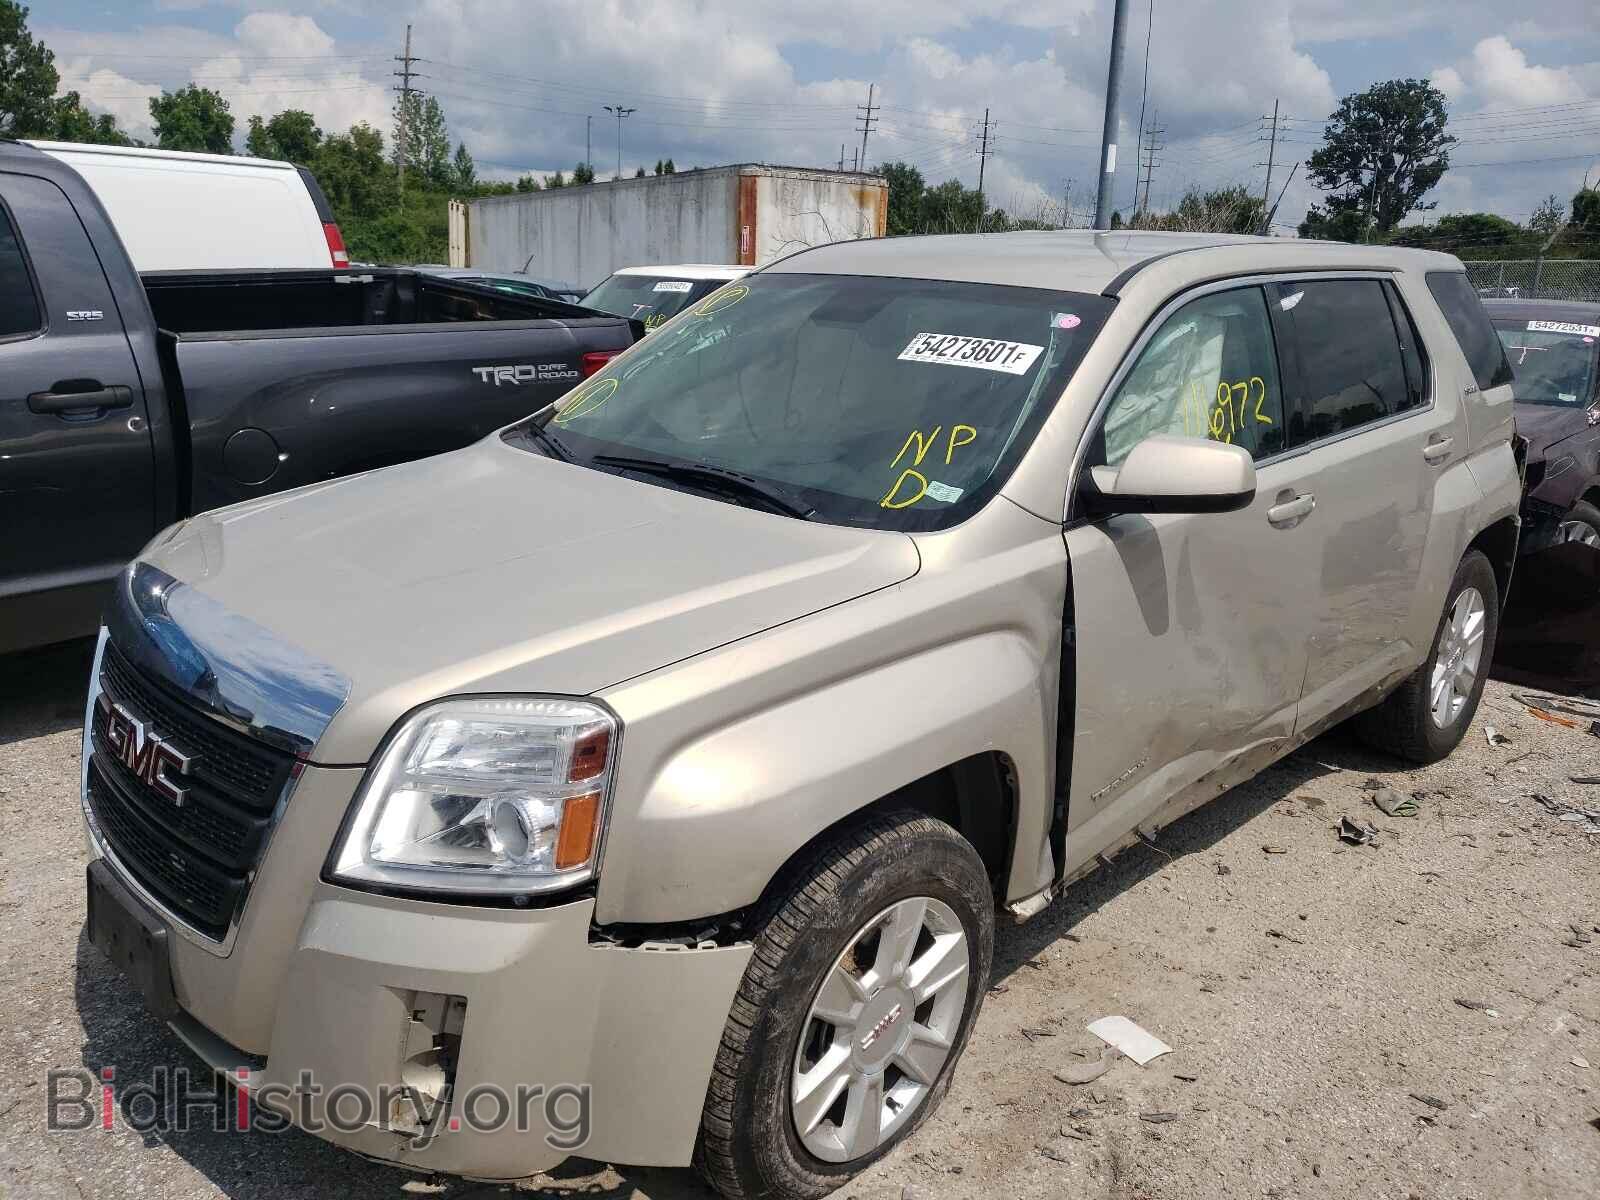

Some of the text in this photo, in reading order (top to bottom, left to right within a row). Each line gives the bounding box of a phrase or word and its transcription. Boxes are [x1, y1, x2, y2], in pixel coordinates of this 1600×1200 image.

[472, 365, 537, 386] TRD
[538, 363, 568, 371] OFF
[538, 371, 579, 379] ROAD
[880, 468, 928, 509] D
[105, 703, 189, 808] GMC
